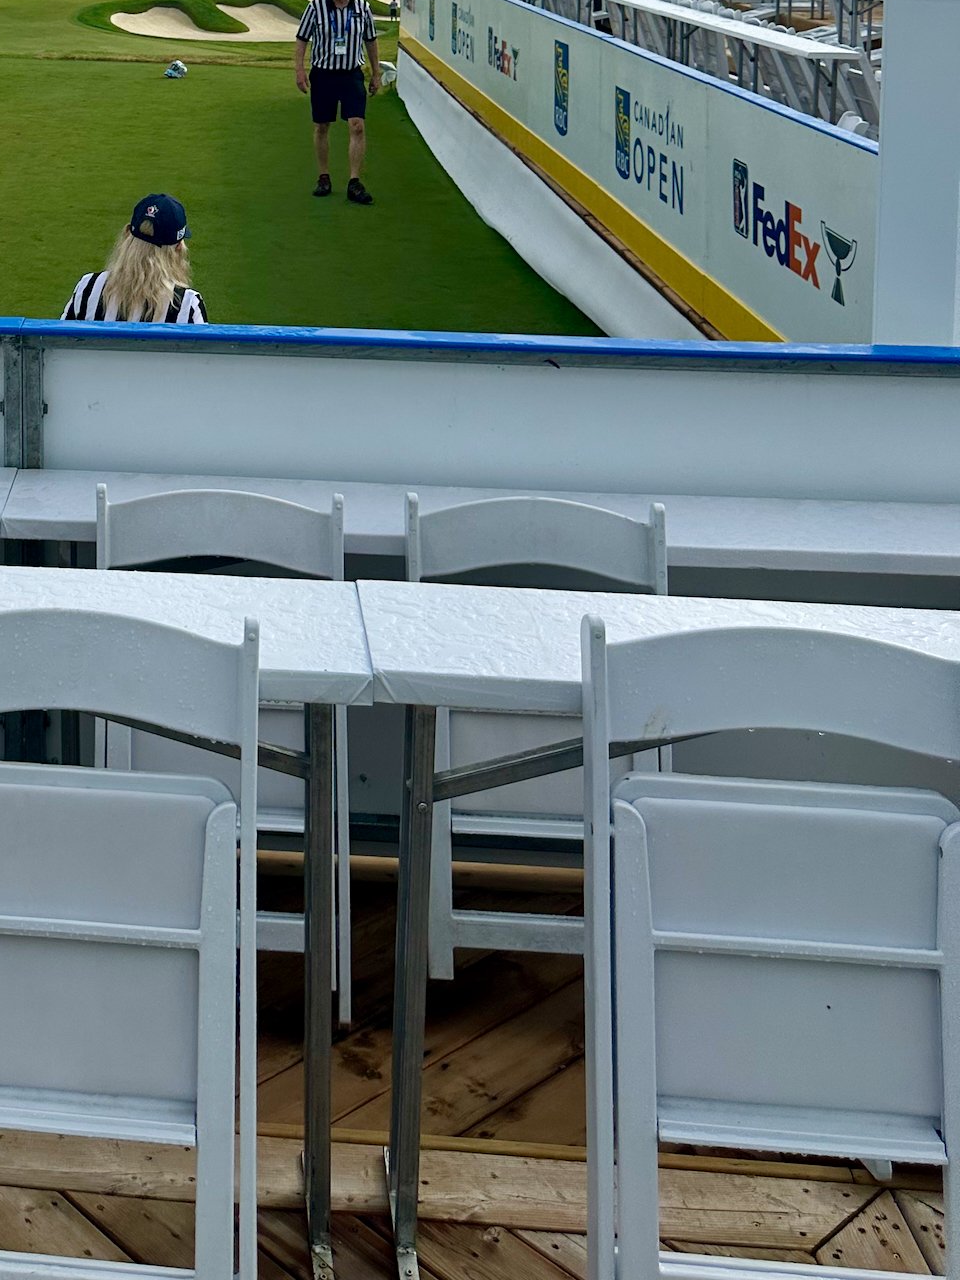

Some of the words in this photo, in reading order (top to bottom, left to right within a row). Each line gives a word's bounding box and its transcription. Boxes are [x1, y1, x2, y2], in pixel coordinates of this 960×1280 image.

[458, 28, 474, 64] OPEN
[494, 35, 511, 78] FedEx
[555, 106, 567, 131] RBC
[634, 101, 683, 149] CANADIAN
[616, 150, 629, 175] RBC
[633, 137, 683, 215] OPEN
[753, 181, 820, 290] FedEx
